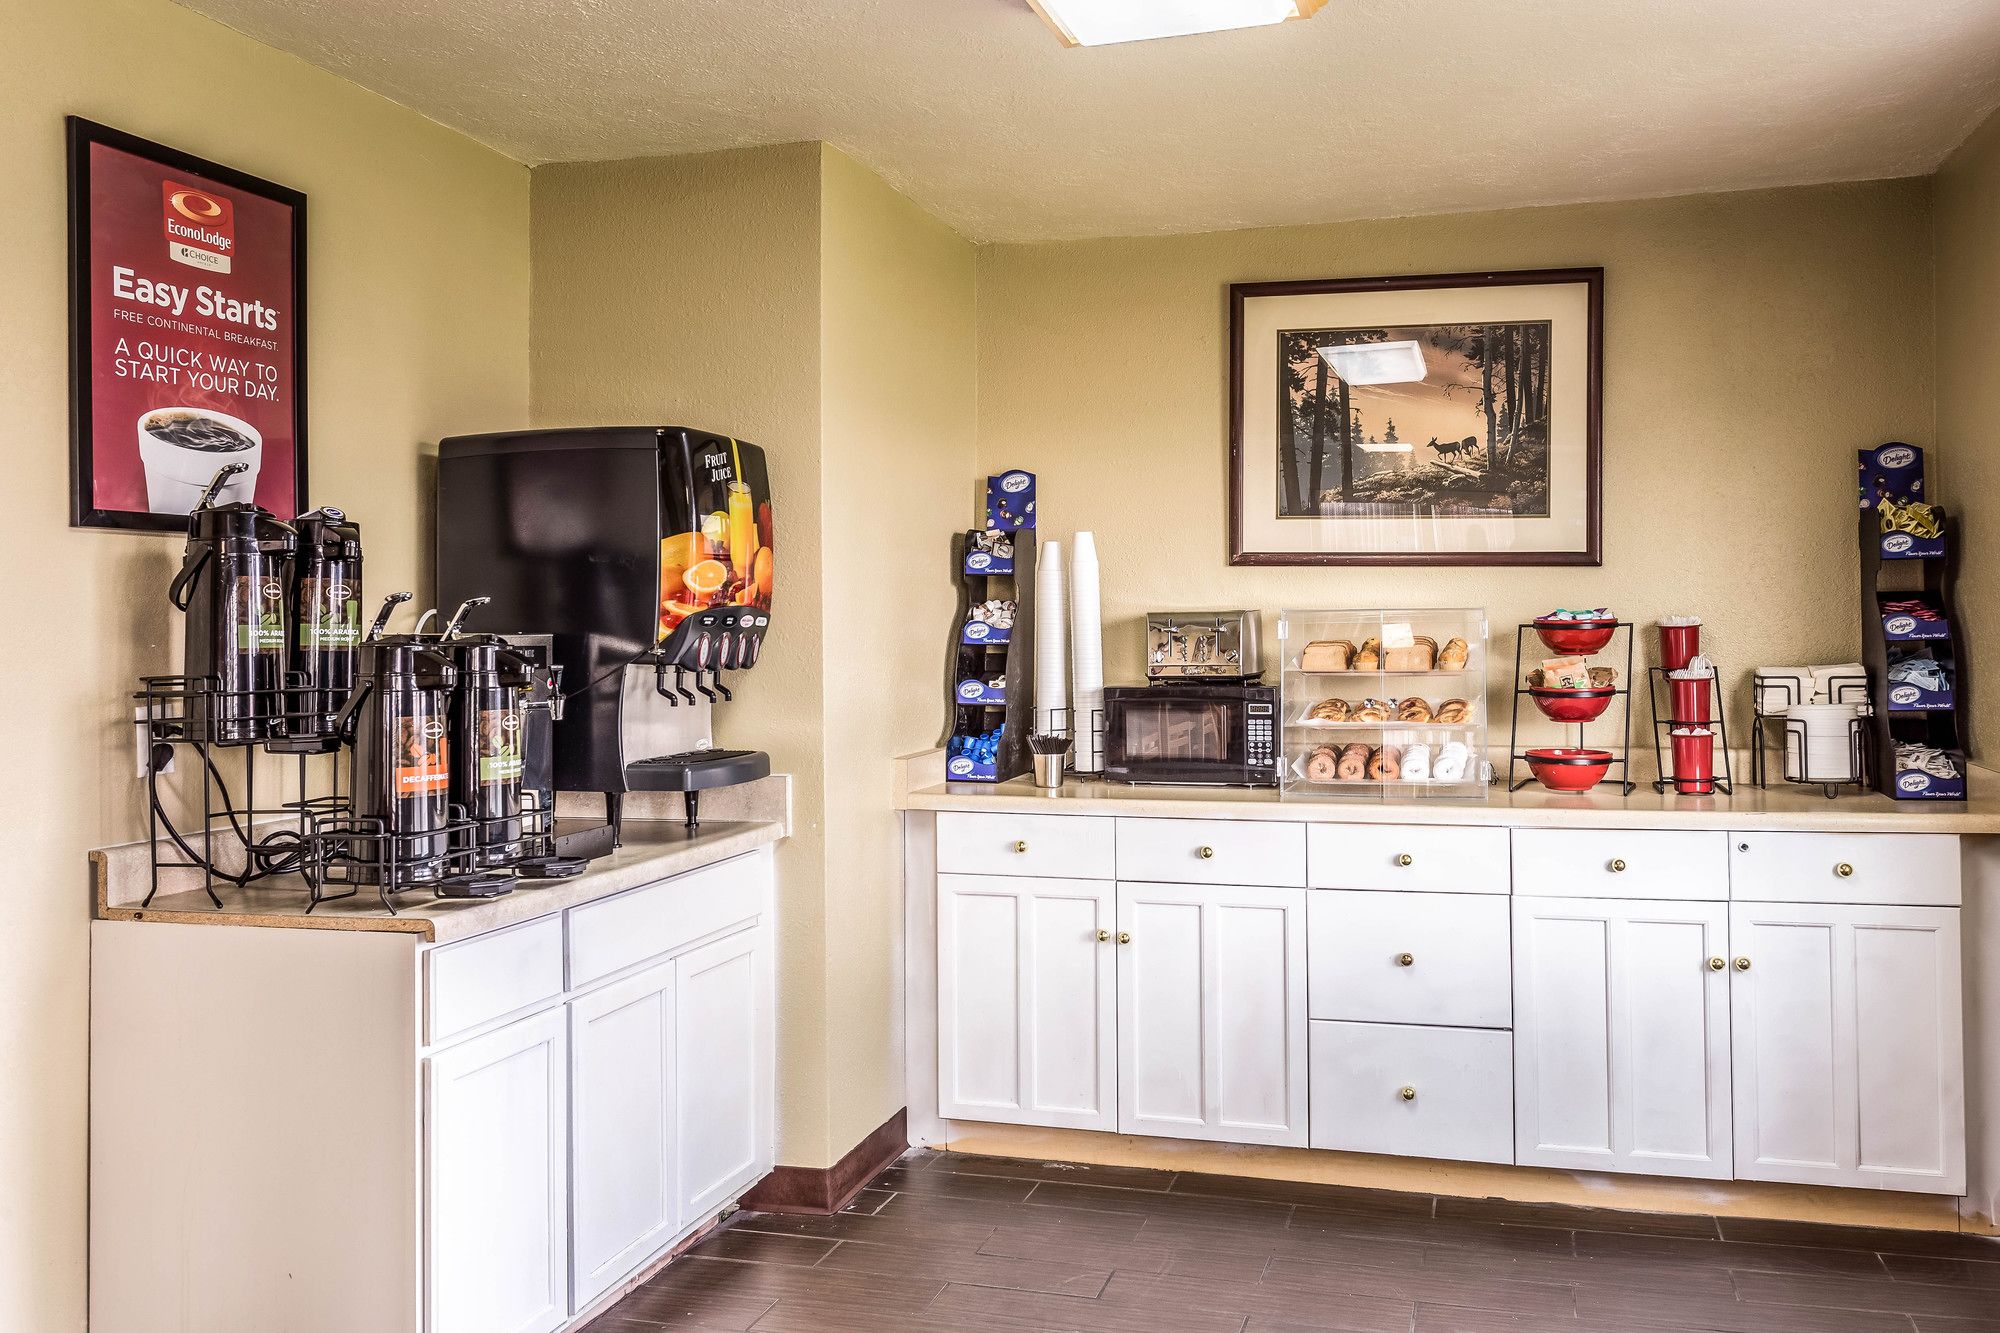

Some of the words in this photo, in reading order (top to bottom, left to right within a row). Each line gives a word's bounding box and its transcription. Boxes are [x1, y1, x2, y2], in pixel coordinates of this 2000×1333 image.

[168, 218, 231, 250] EconoLodge
[189, 250, 218, 264] CHOICE
[113, 266, 189, 316] Easy
[195, 285, 278, 331] Starts
[114, 309, 143, 323] FREE
[147, 316, 221, 339] CONTINENTAL
[224, 331, 279, 352] BREAKFAST.
[114, 338, 131, 356] A
[138, 342, 203, 368] QUICK
[209, 354, 250, 376] WAY
[255, 363, 278, 382] TO
[115, 359, 181, 384] START
[187, 370, 239, 395] YOUR
[245, 380, 280, 401] DAY.
[1883, 453, 1911, 465] Delight
[1005, 479, 1026, 490] Delight
[1886, 540, 1909, 550] Delight
[1890, 622, 1912, 632] Delight
[1893, 692, 1916, 702] Delight
[1902, 780, 1925, 789] Delight
